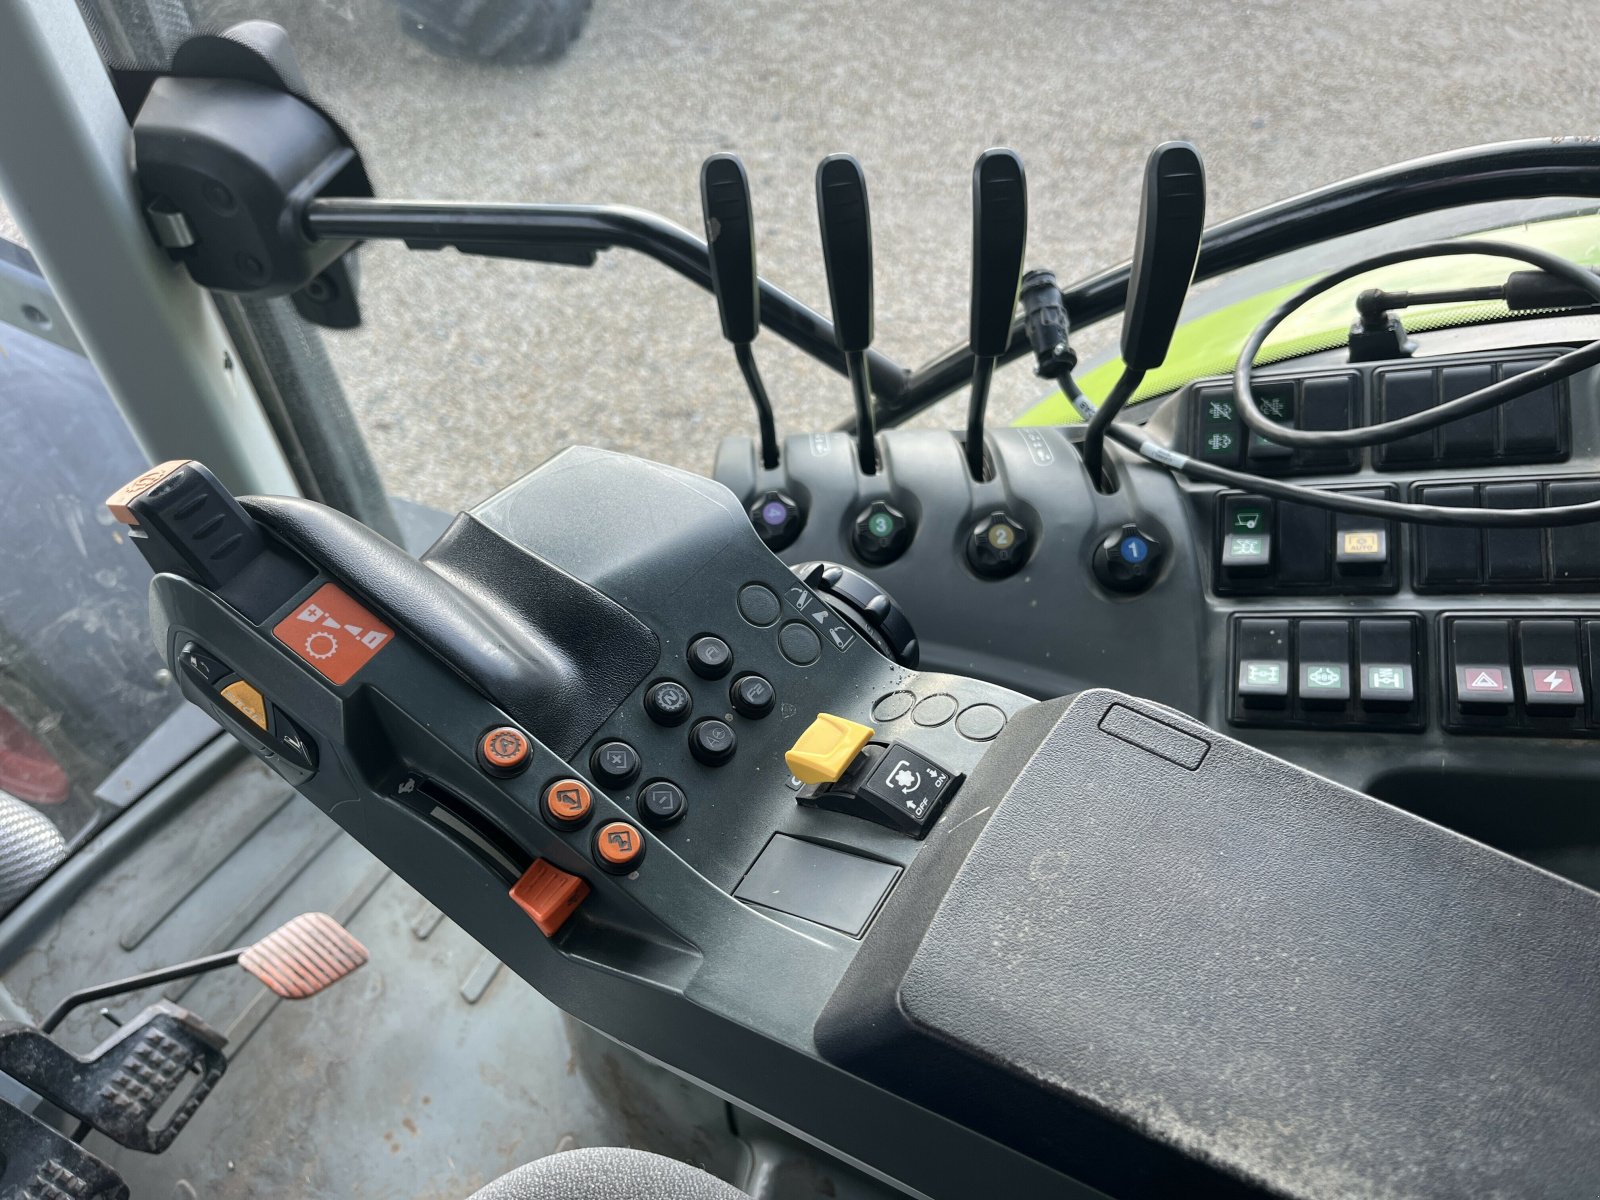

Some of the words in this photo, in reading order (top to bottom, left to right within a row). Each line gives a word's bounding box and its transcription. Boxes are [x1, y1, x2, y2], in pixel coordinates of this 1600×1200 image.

[876, 516, 887, 532] 3
[996, 529, 1008, 544] 2
[1128, 541, 1138, 558] 1
[663, 690, 678, 706] N
[746, 682, 766, 702] F2
[934, 773, 947, 788] ON
[915, 796, 929, 816] OFF
